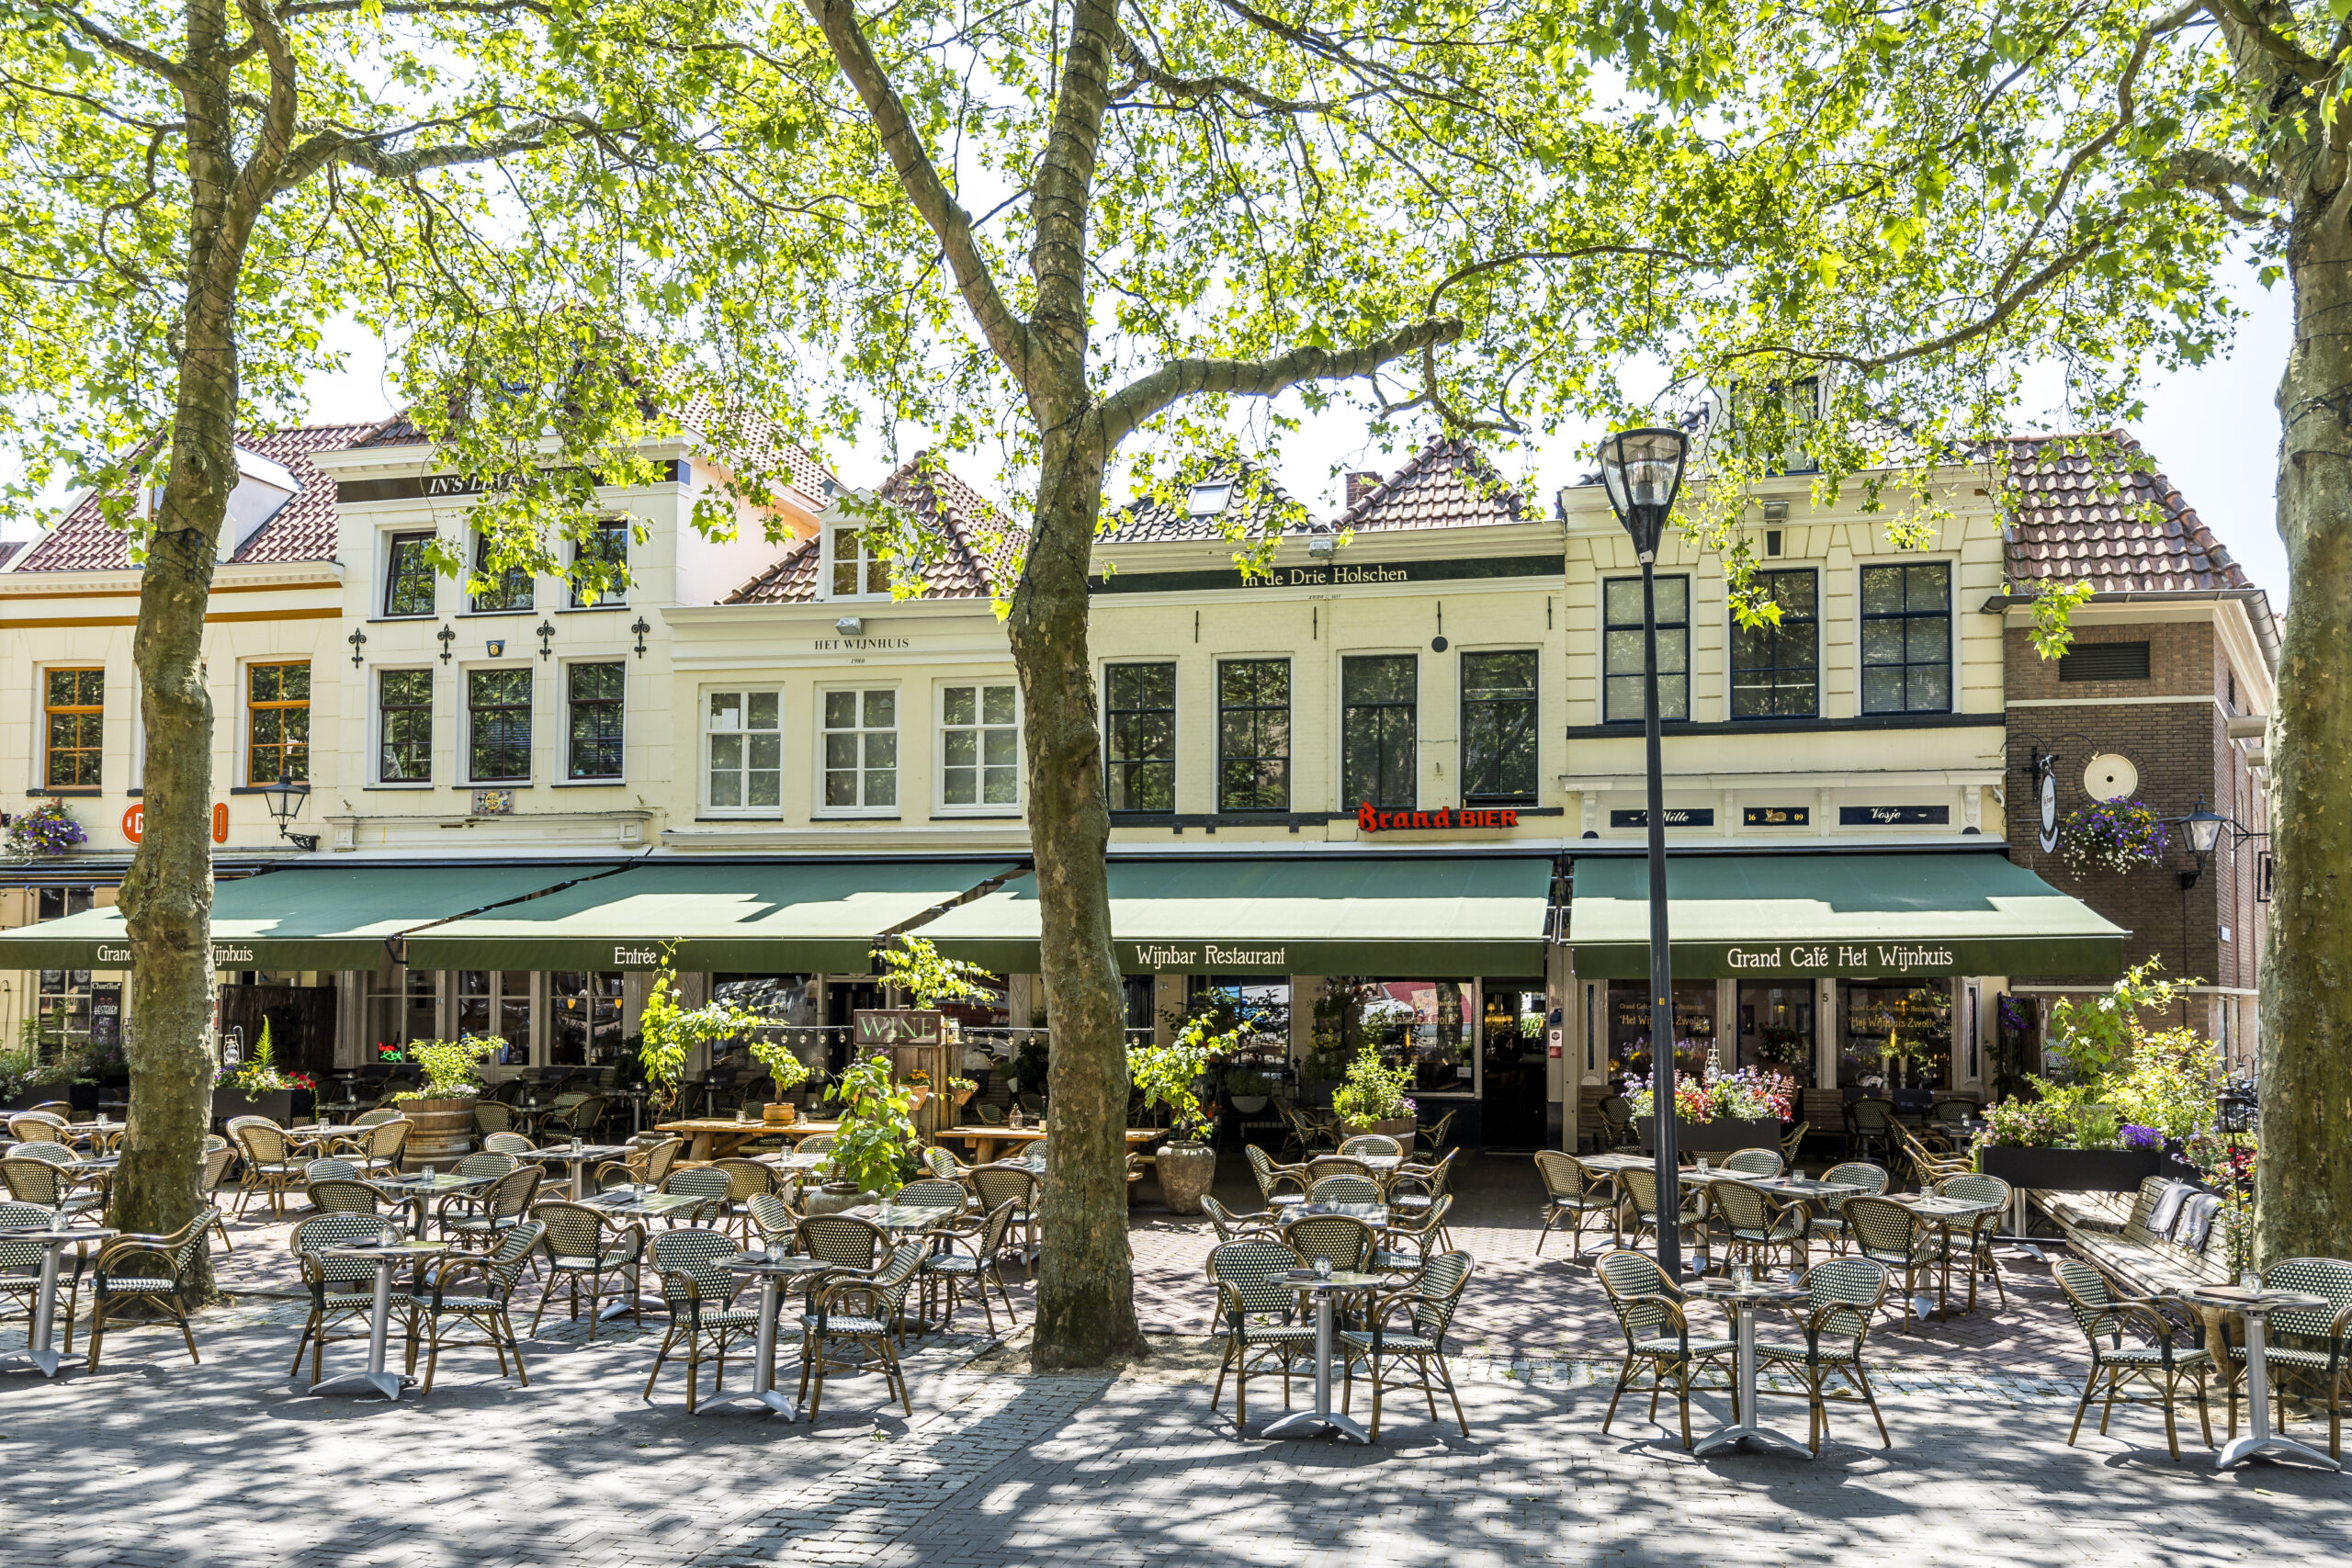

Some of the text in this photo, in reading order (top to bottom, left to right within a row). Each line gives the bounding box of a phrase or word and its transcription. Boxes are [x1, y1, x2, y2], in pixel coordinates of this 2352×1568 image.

[428, 478, 462, 494] IN'S
[1264, 570, 1283, 586] de
[1290, 569, 1326, 585] Drie
[1333, 565, 1408, 583] Holschen
[815, 637, 910, 650] HET WIJNHUIS
[1358, 801, 1519, 833] Brand BIER
[1748, 813, 1757, 821] 16
[1793, 813, 1804, 821] 09
[1870, 807, 1902, 823] Vosje
[614, 946, 657, 964] Entrée
[1135, 944, 1285, 970] Wijnbar Restaurant
[1727, 945, 1953, 972] Grand Café Het Wijnhuis
[1823, 993, 1829, 1002] 5
[859, 1016, 936, 1038] WINE
[1505, 1038, 1514, 1050] 4
